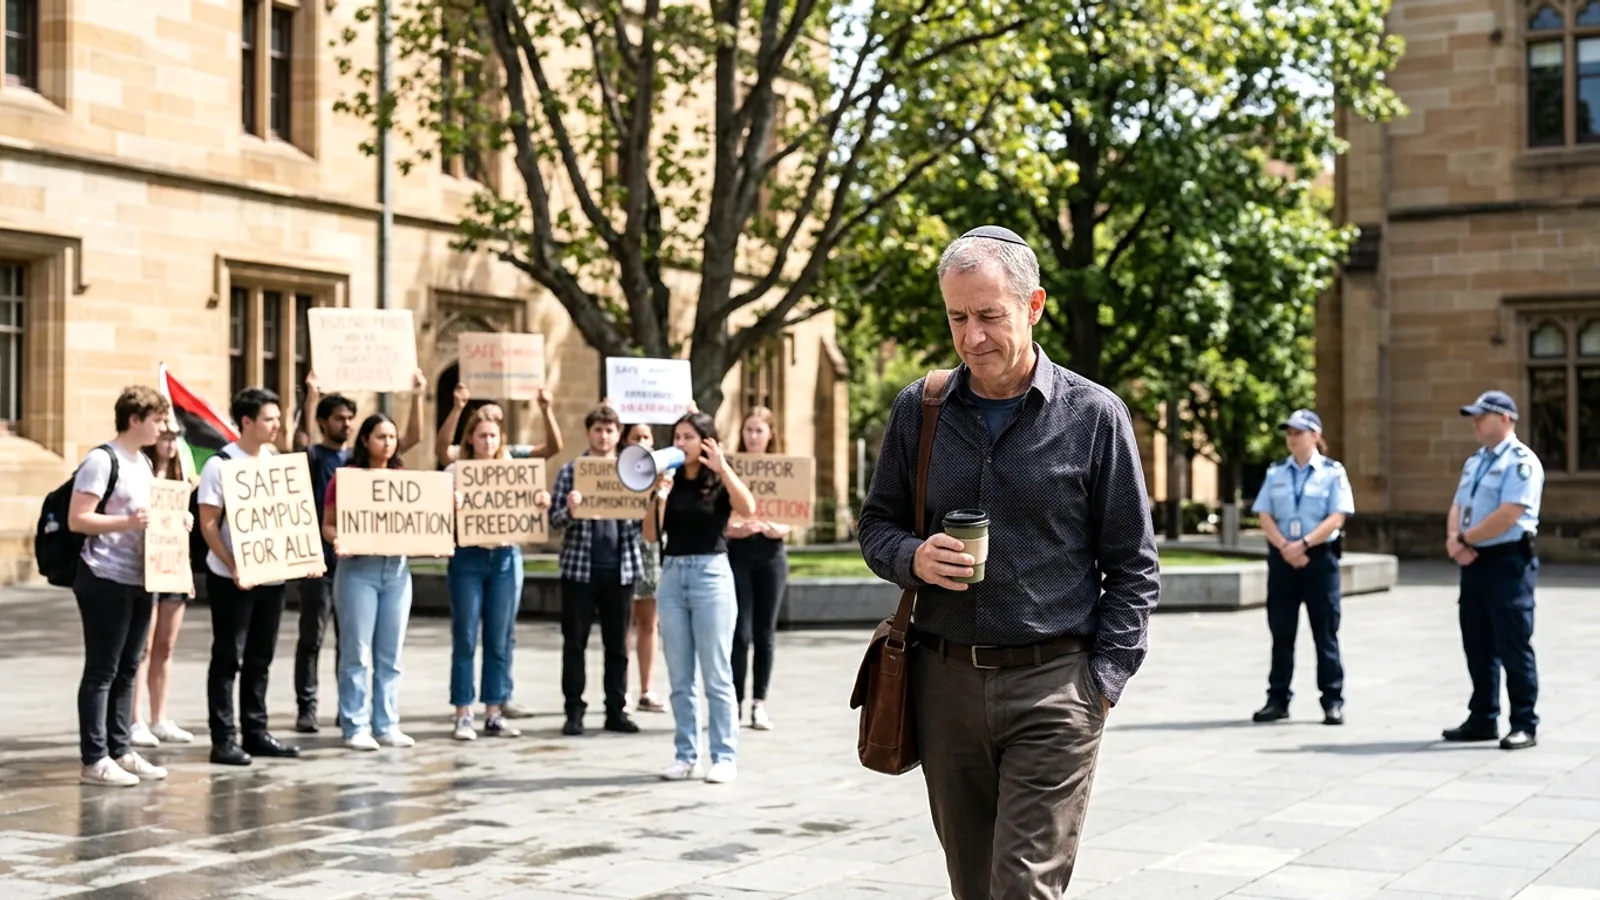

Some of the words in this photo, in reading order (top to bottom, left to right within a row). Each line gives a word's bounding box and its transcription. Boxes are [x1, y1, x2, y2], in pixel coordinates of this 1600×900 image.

[235, 466, 300, 500] SAFE
[462, 464, 540, 487] SUPPORT
[372, 479, 421, 503] END
[461, 489, 543, 510] ACADEMIC
[749, 480, 777, 496] FOR
[235, 499, 313, 533] CAMPUS
[756, 499, 810, 519] ECTION
[342, 510, 452, 535] INTIMIDATION
[464, 513, 544, 537] FREEDOM
[240, 537, 278, 567] FOR
[285, 533, 318, 561] ALL
